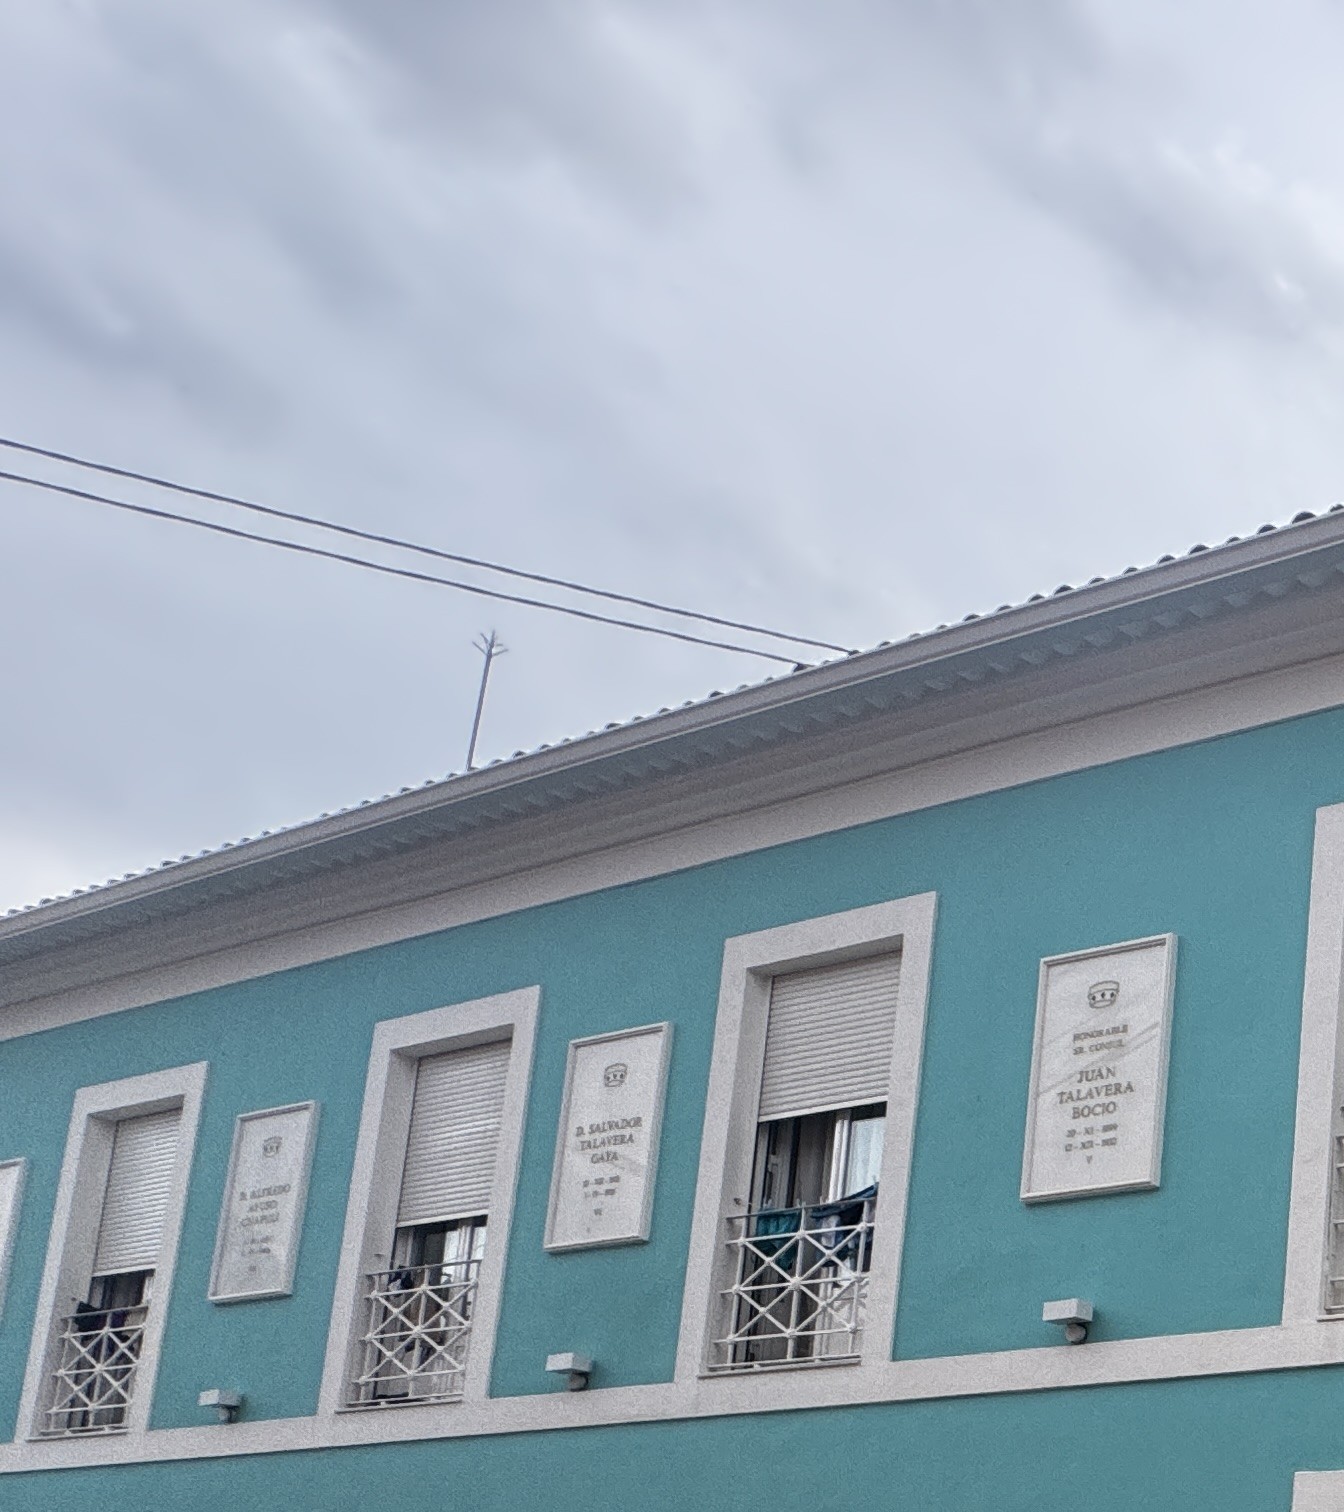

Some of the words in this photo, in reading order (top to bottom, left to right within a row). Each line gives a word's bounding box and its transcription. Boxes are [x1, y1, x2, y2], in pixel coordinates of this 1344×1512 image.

[1077, 1066, 1116, 1083] JUAN
[1057, 1081, 1134, 1105] TALAVERA
[1072, 1101, 1117, 1120] BOCIO
[588, 1116, 643, 1134] SALVADOR
[580, 1133, 635, 1151] TALAVERA
